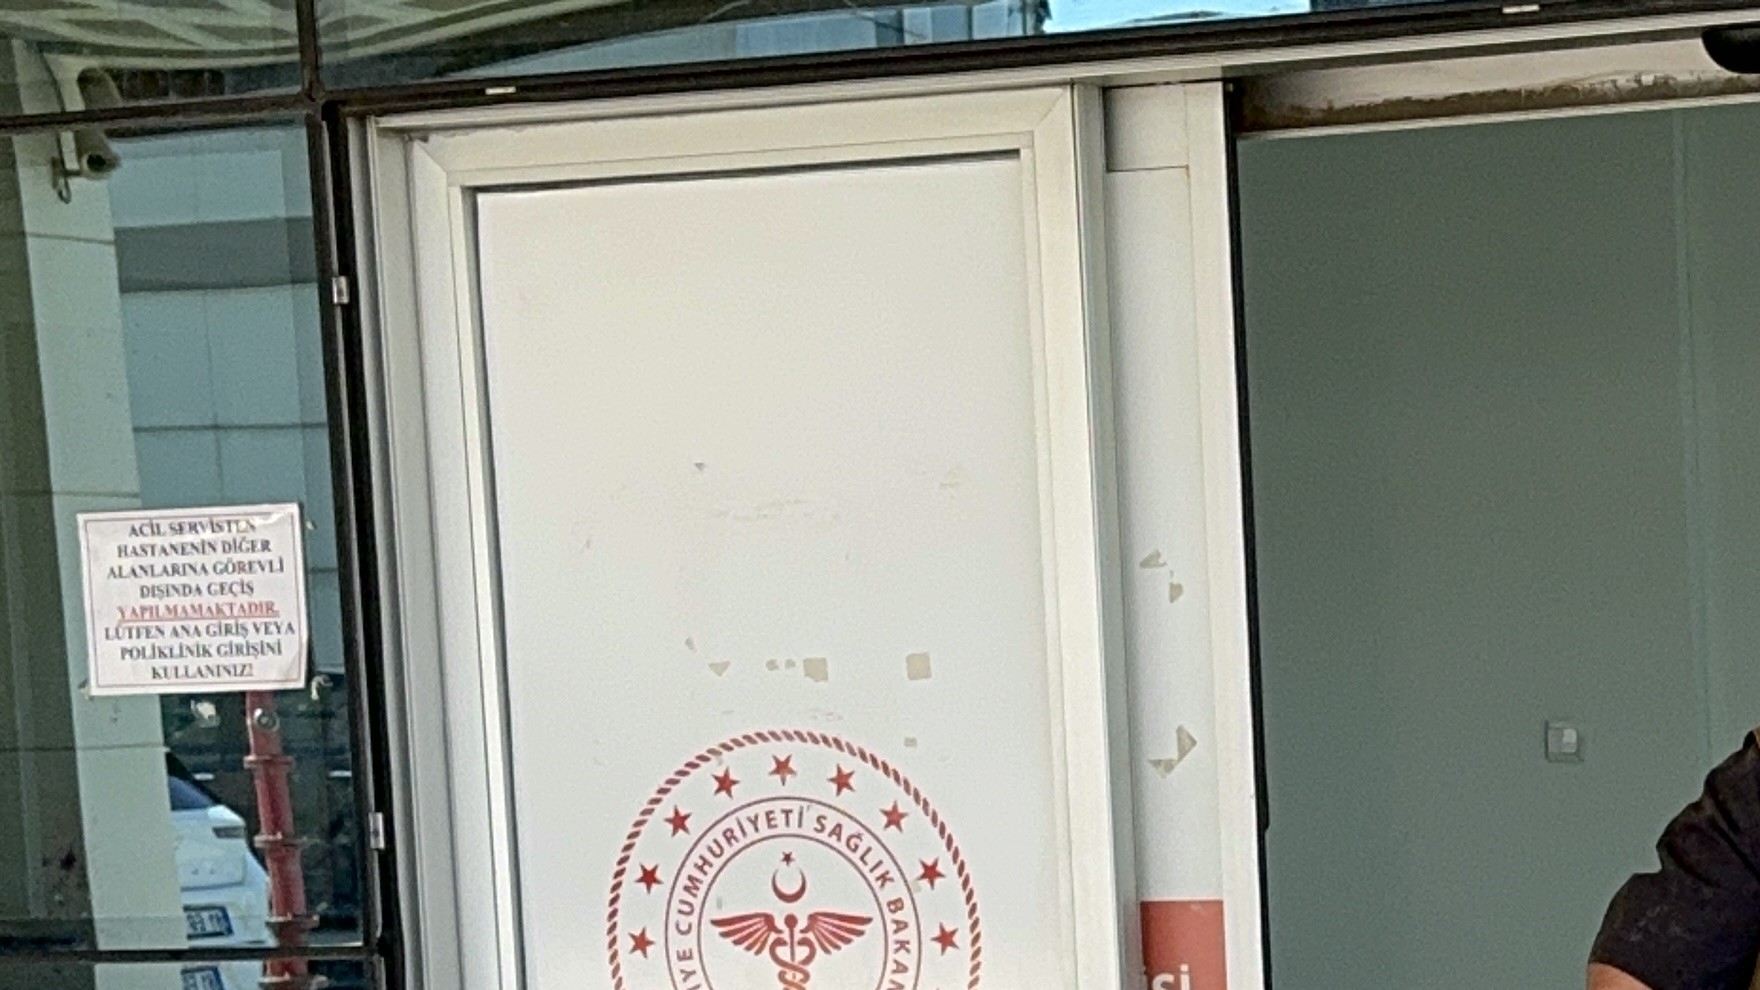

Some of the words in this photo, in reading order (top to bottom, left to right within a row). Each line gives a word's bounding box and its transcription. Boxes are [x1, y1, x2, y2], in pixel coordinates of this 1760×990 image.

[117, 540, 217, 558] HASTANENİN
[222, 537, 272, 554] DİĞER
[107, 562, 209, 580] ALANLARINA
[213, 556, 285, 576] GÖREVLİ
[207, 580, 255, 598] GEÇİŞ
[170, 625, 201, 638] ANA
[205, 620, 249, 639] GİRİŞ
[253, 621, 296, 636] VEYA
[675, 806, 804, 936] CUMHURİYETİ
[813, 814, 895, 890] SAĞLIK
